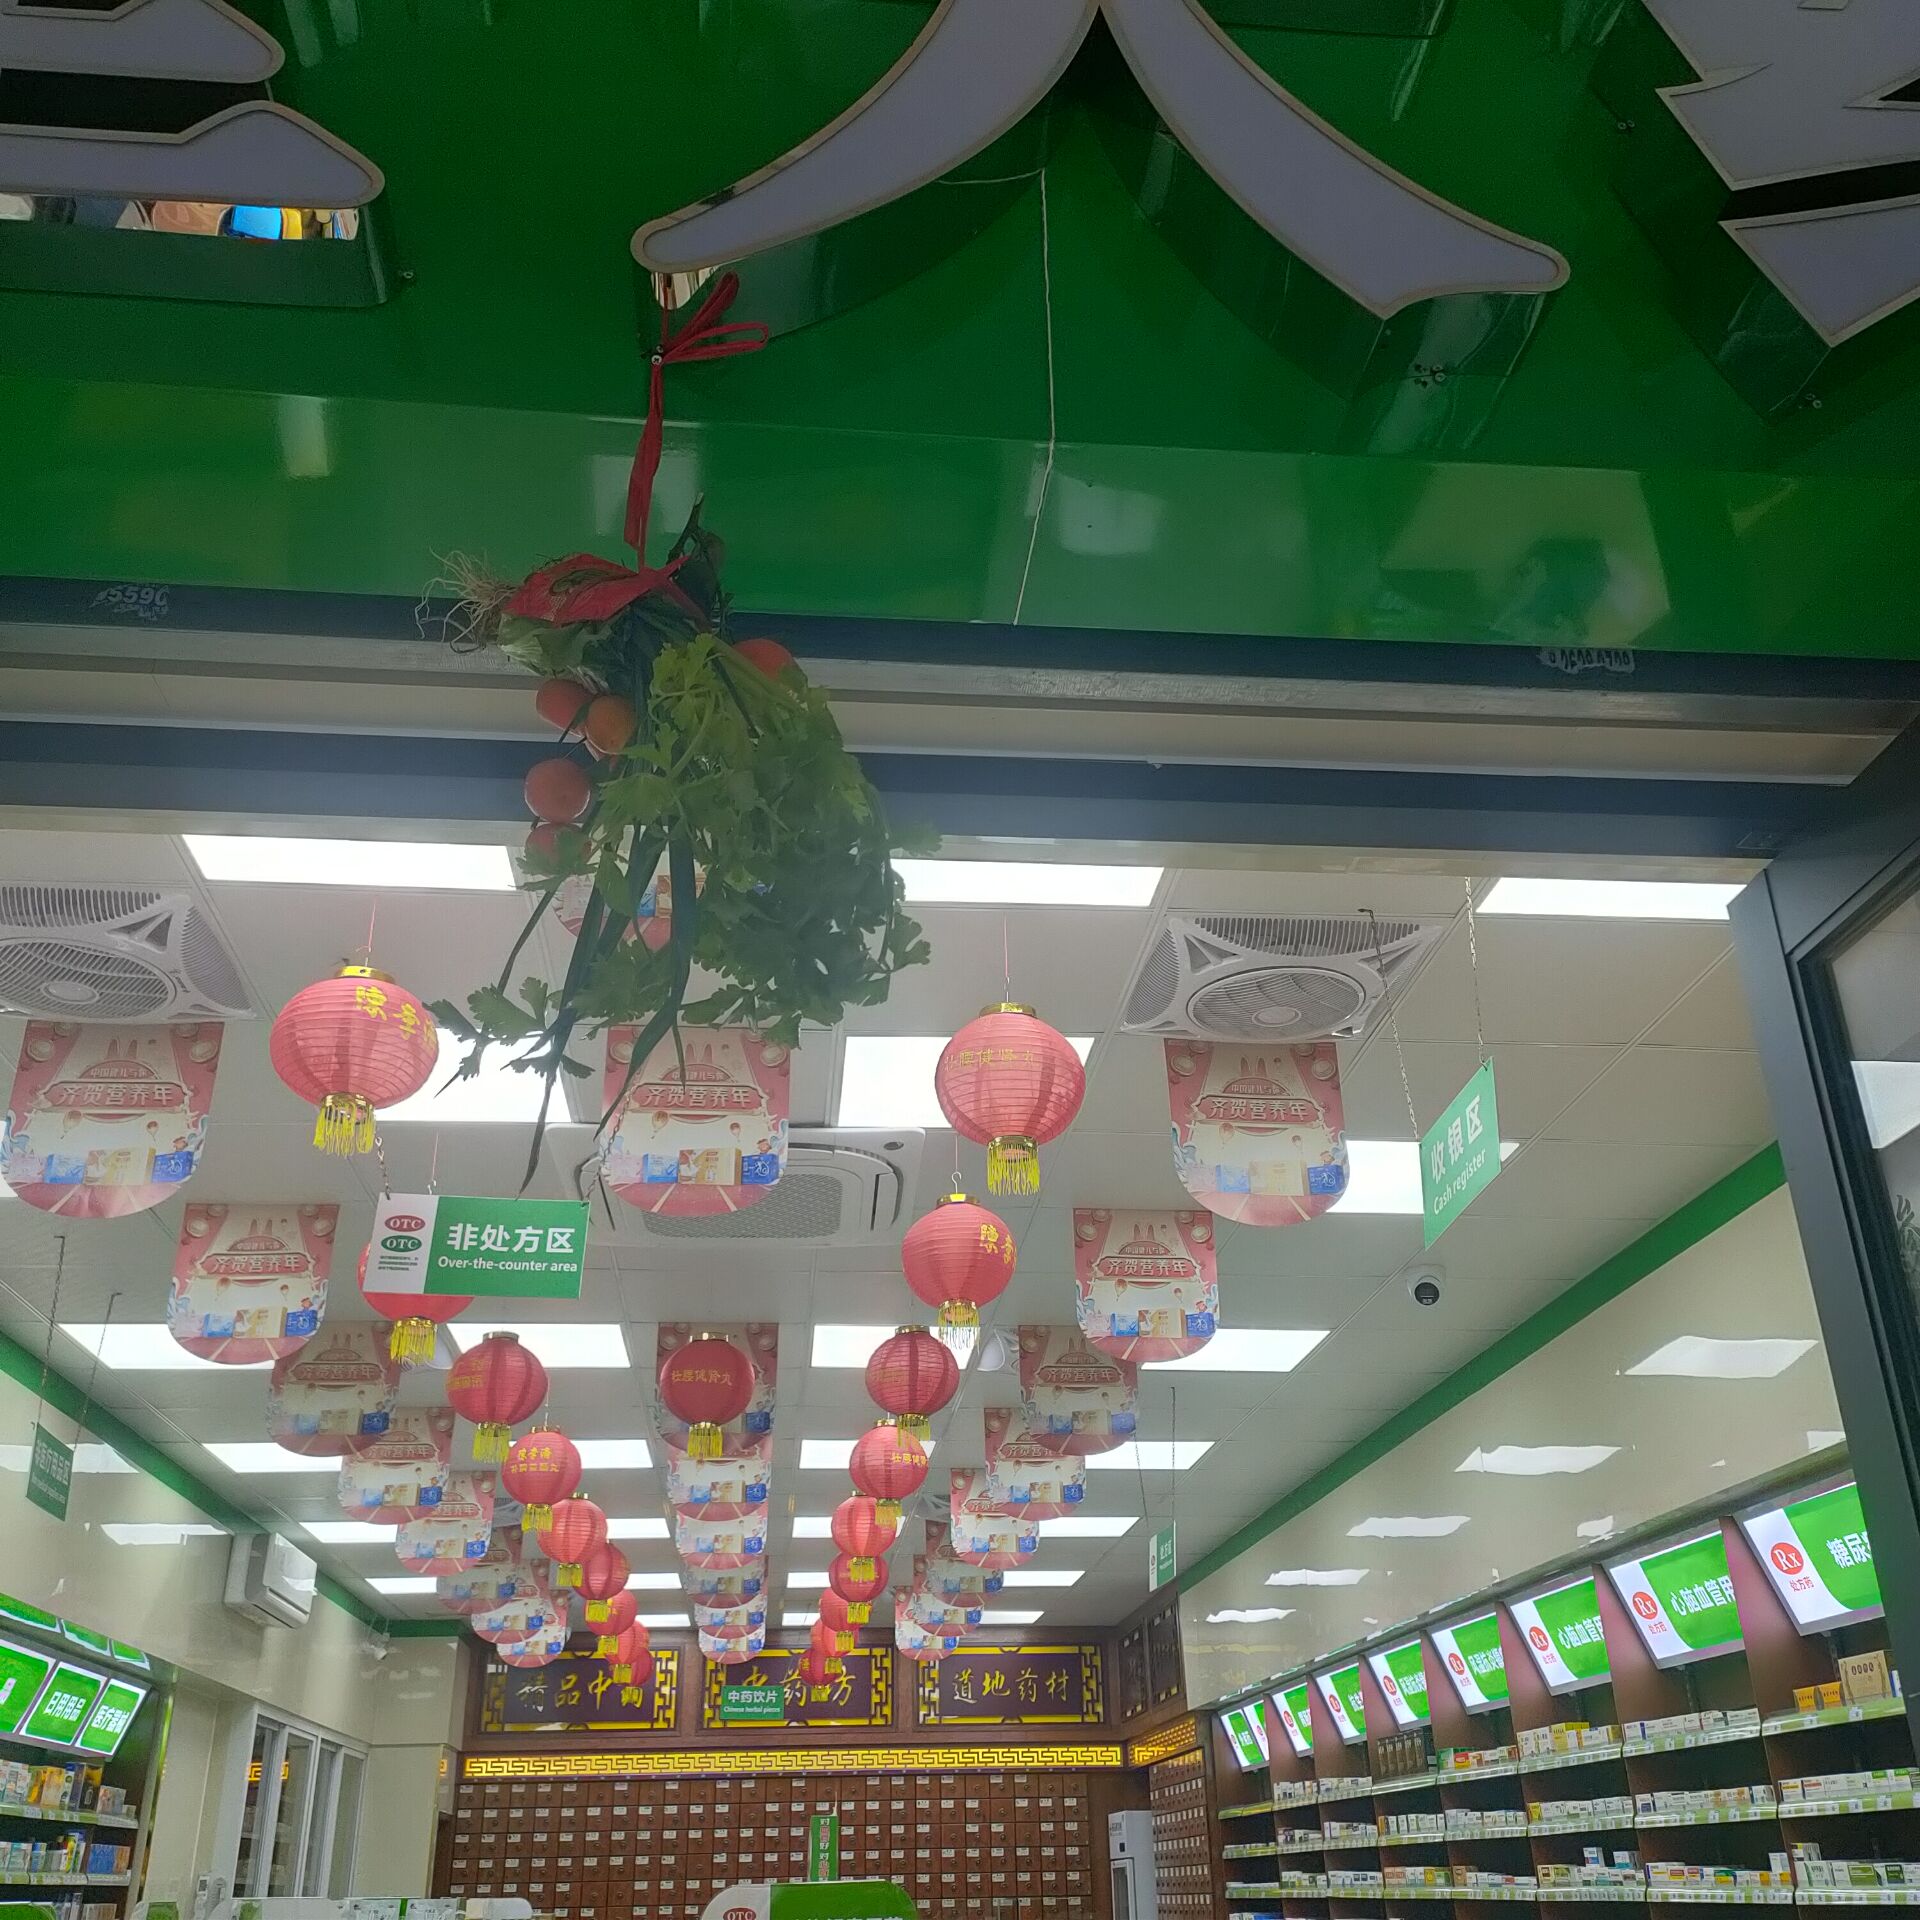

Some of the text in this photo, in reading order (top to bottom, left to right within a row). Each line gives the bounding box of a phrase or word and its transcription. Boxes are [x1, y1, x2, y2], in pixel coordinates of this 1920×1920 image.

[59, 1083, 173, 1105] 齐贺营养年
[644, 1086, 751, 1108] 齐贺营养年
[1210, 1098, 1309, 1121] 齐贺营养年
[1431, 1095, 1484, 1184] 收银区
[1433, 1148, 1486, 1215] Cash register
[389, 1218, 422, 1230] OTC
[386, 1239, 419, 1250] OTC
[447, 1223, 576, 1253] 非处方区
[212, 1255, 299, 1273] 齐贺营养年
[438, 1256, 578, 1272] Over-the-counter area
[1107, 1259, 1189, 1276] 齐贺营养年
[1773, 1549, 1802, 1571] Rx
[1789, 1576, 1815, 1592] 处方药
[1634, 1597, 1656, 1617] Rx
[1530, 1630, 1549, 1649] Rx
[728, 1690, 778, 1703] 中药饮片
[951, 1668, 1069, 1705] 道地药材
